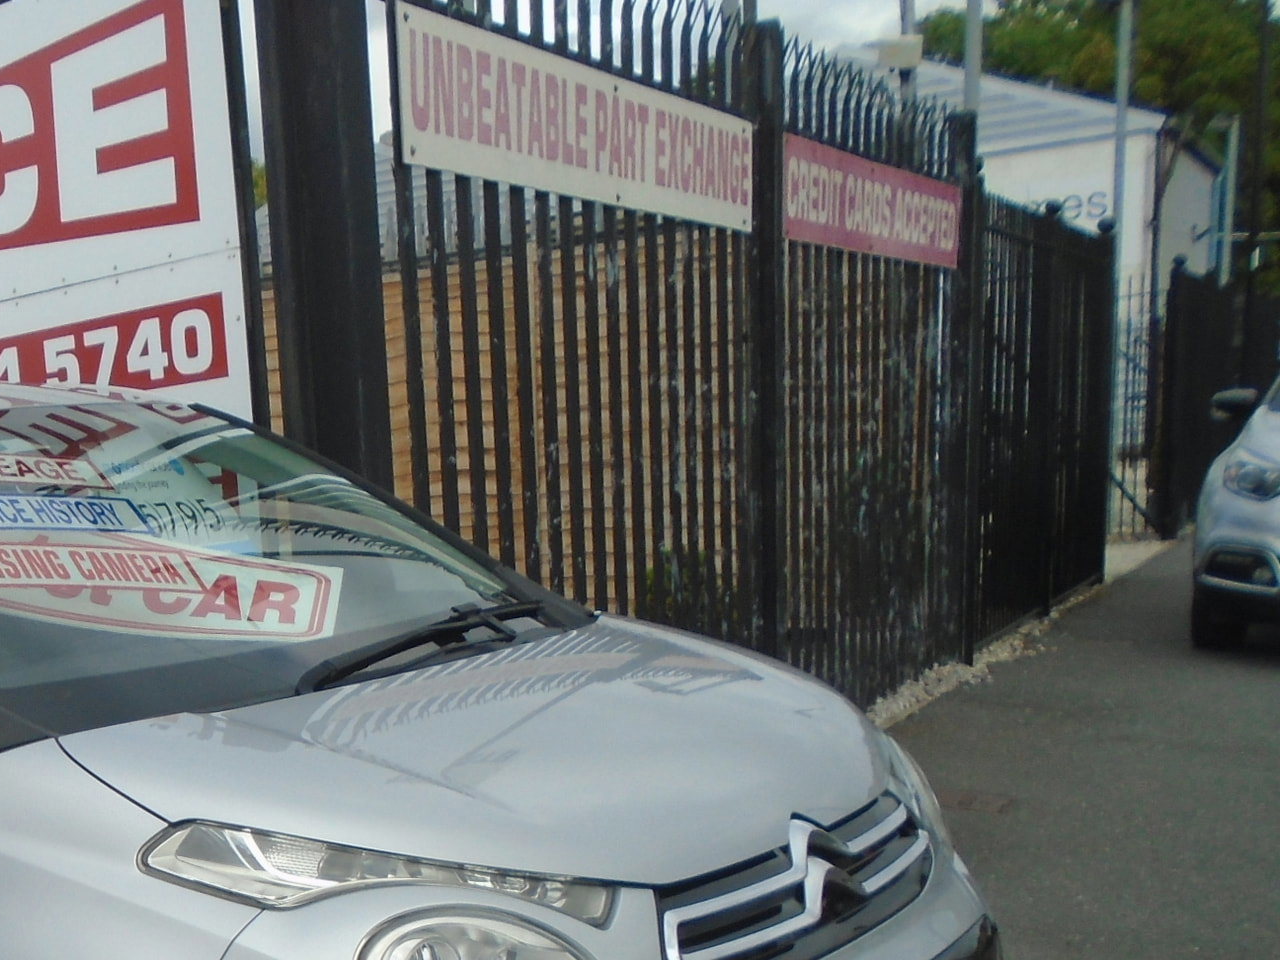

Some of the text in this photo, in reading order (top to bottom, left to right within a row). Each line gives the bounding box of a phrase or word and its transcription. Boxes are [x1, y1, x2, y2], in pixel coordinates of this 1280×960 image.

[409, 28, 750, 206] UNBEATABLE PART EXCHANGE
[787, 156, 957, 251] CREDIT CARDS ACCEPTED
[43, 308, 213, 390] 5740
[31, 499, 125, 527] HISTORY
[68, 550, 188, 585] CAMERA
